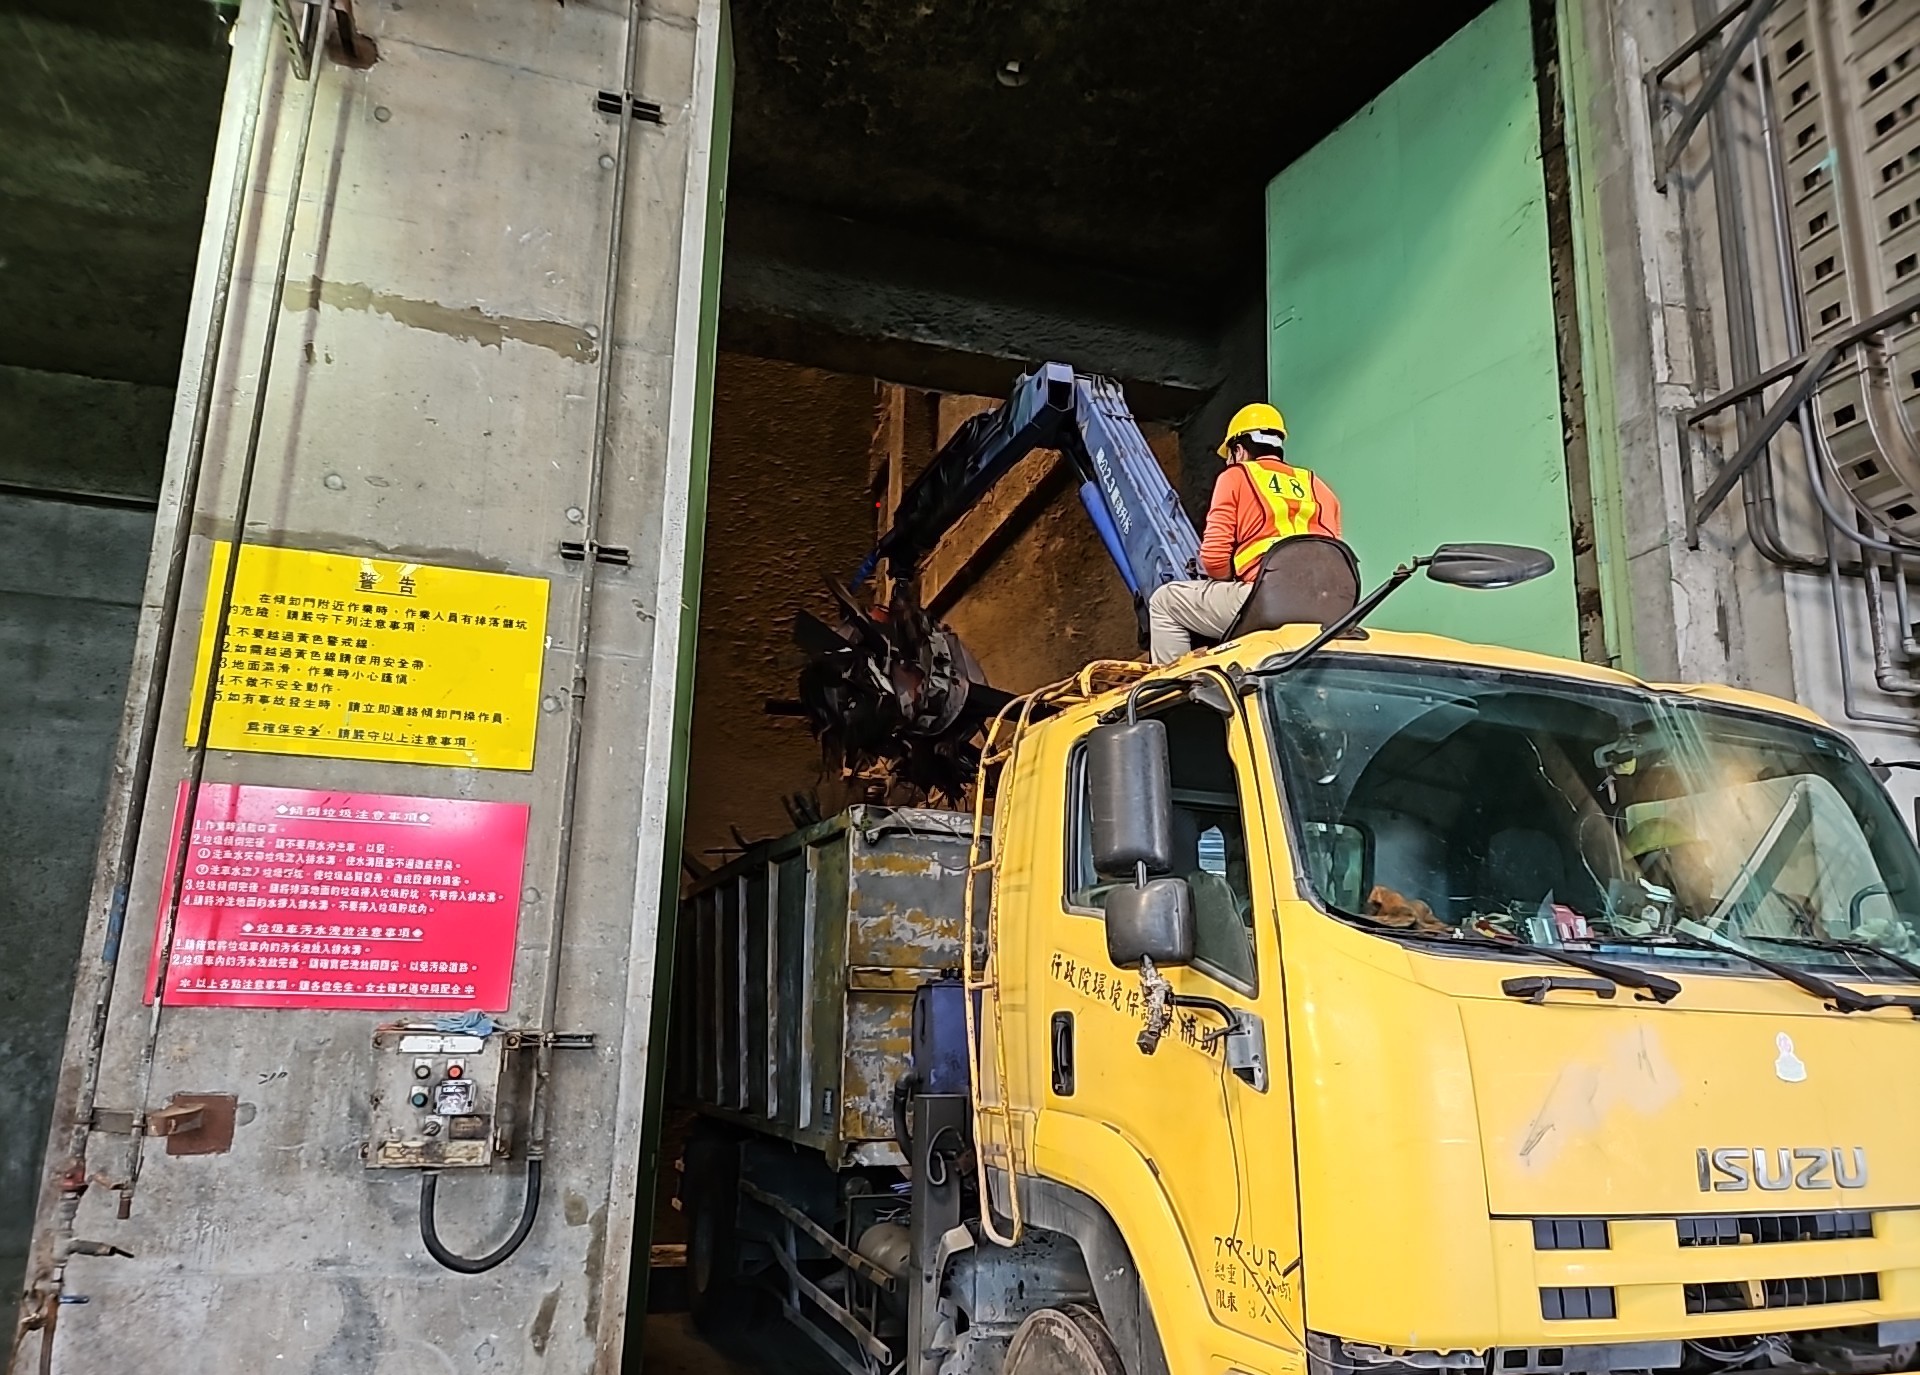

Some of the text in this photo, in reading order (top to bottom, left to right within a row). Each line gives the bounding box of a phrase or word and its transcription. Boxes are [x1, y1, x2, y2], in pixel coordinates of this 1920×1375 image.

[1269, 473, 1305, 498] 48
[359, 571, 417, 594] 警告
[1051, 952, 1219, 1057] 行政院環境保補助
[1697, 1147, 1867, 1192] ISUZU
